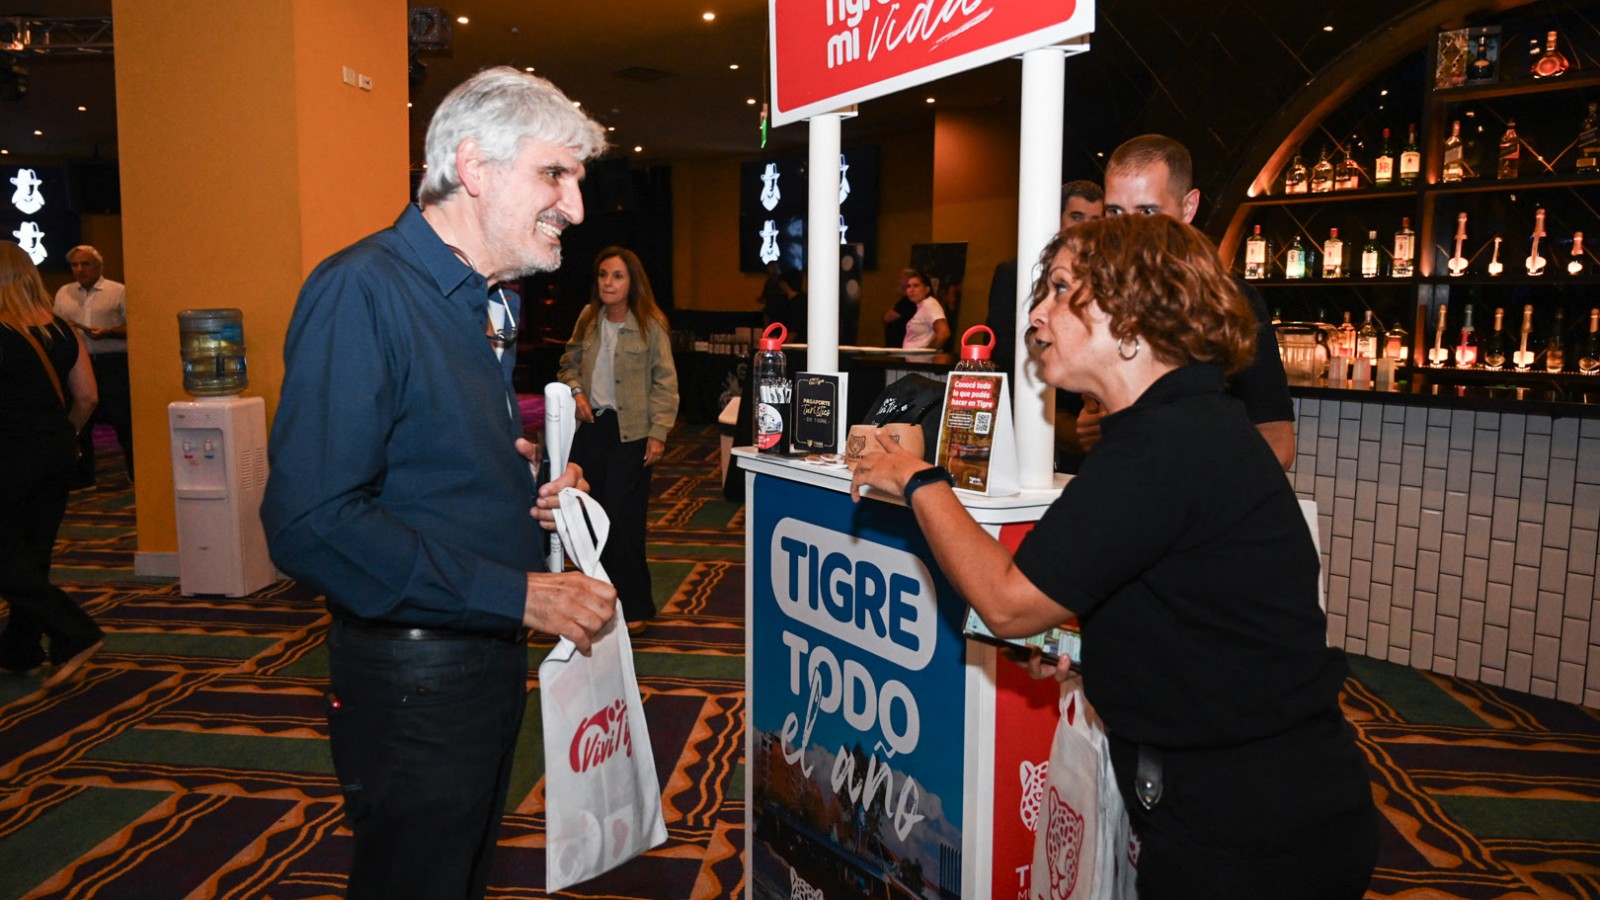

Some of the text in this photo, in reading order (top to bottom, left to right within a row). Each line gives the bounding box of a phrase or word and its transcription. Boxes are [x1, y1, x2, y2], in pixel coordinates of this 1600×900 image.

[826, 0, 891, 28] Tig
[827, 27, 860, 69] mi
[781, 536, 921, 652] TIGRE
[782, 630, 920, 755] TODO
[780, 666, 926, 843] el año
